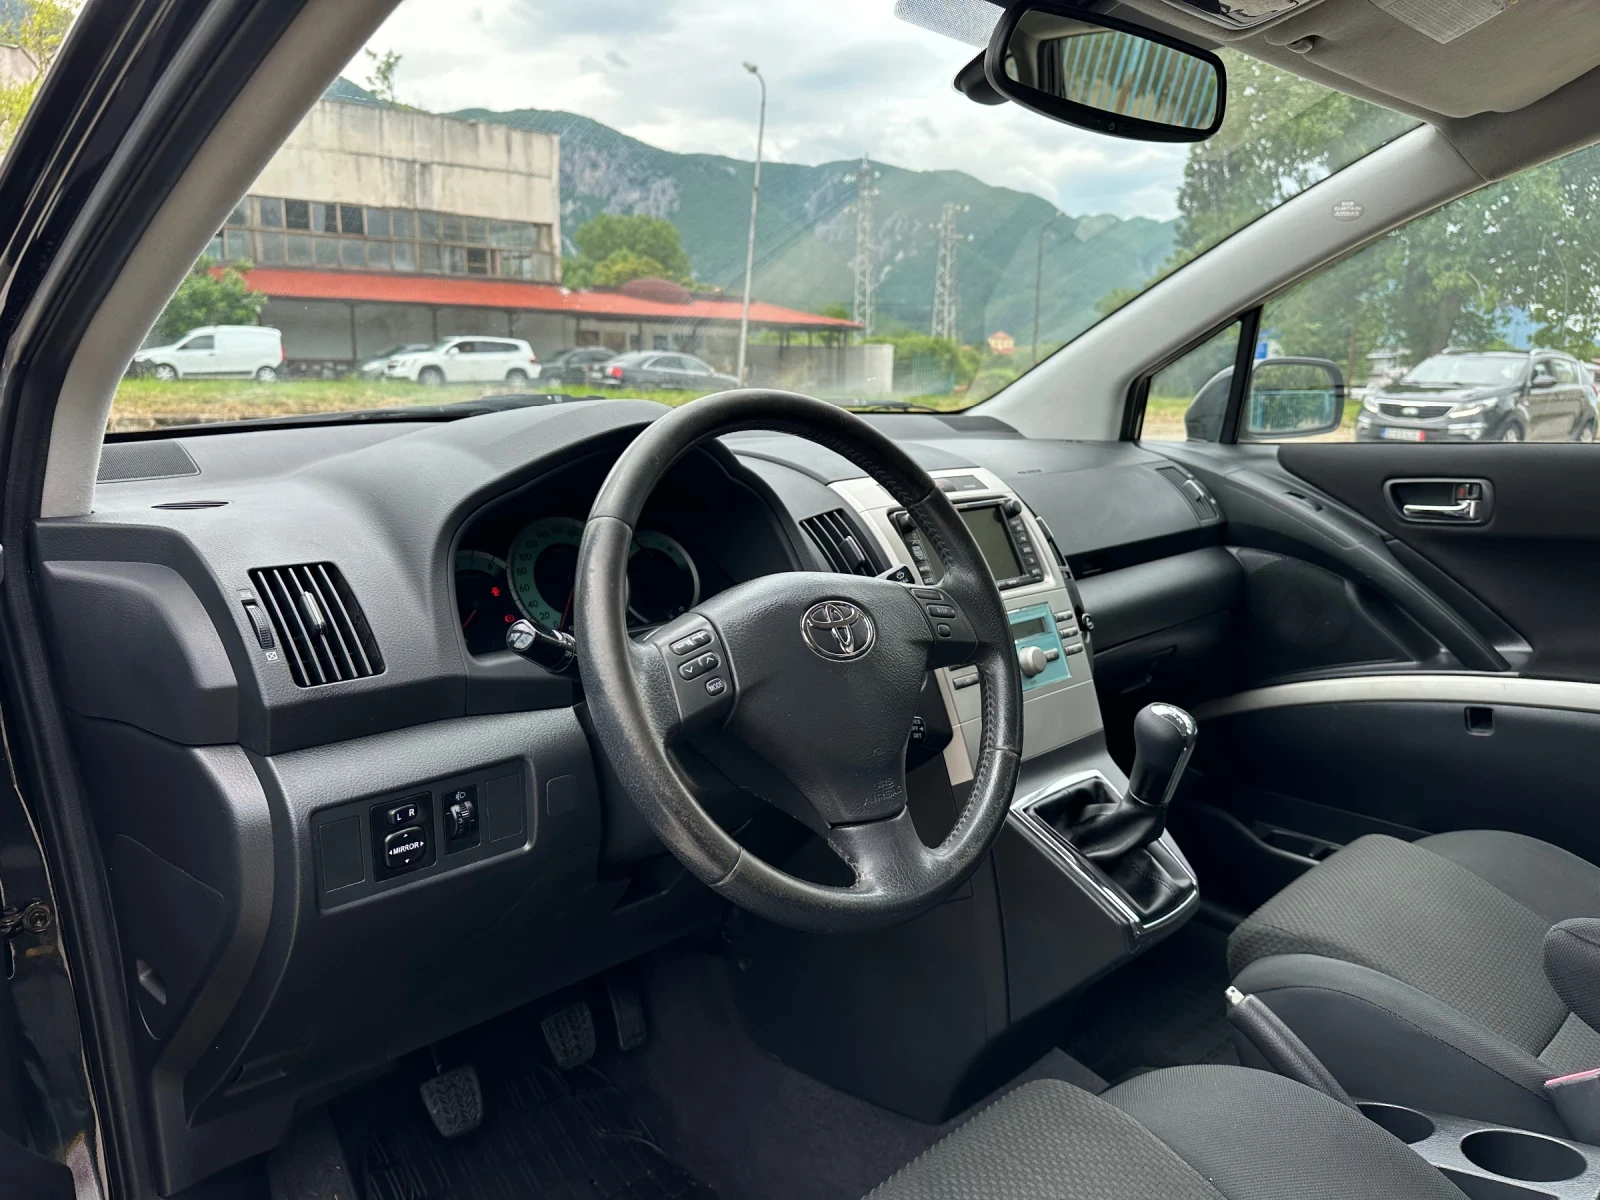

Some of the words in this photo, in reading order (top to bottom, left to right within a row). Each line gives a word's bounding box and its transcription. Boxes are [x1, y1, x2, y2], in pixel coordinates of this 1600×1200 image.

[525, 539, 539, 548] 120
[518, 553, 532, 561] 100
[516, 567, 528, 576] 80
[519, 584, 530, 593] 60
[528, 600, 539, 608] 40
[539, 611, 550, 620] 20
[553, 620, 559, 628] 0
[708, 681, 724, 692] MODE
[396, 813, 402, 821] L
[408, 808, 415, 817] R
[393, 841, 420, 855] MIRROR
